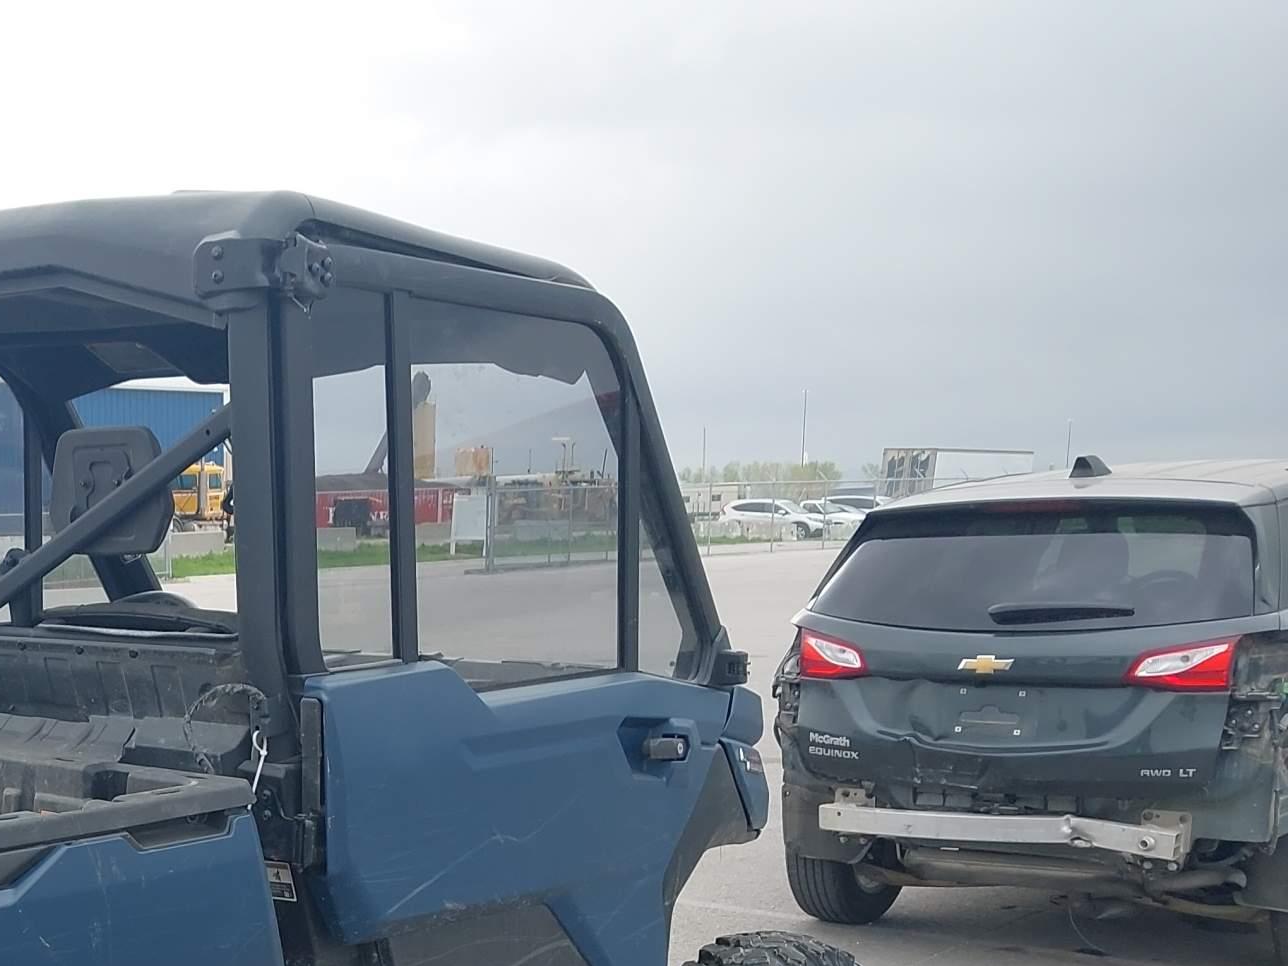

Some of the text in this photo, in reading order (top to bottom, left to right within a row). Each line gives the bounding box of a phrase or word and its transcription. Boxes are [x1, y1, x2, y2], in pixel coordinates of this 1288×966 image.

[809, 731, 850, 747] McGrath
[808, 746, 860, 760] EQUINOX
[1140, 768, 1196, 778] AWD LT
